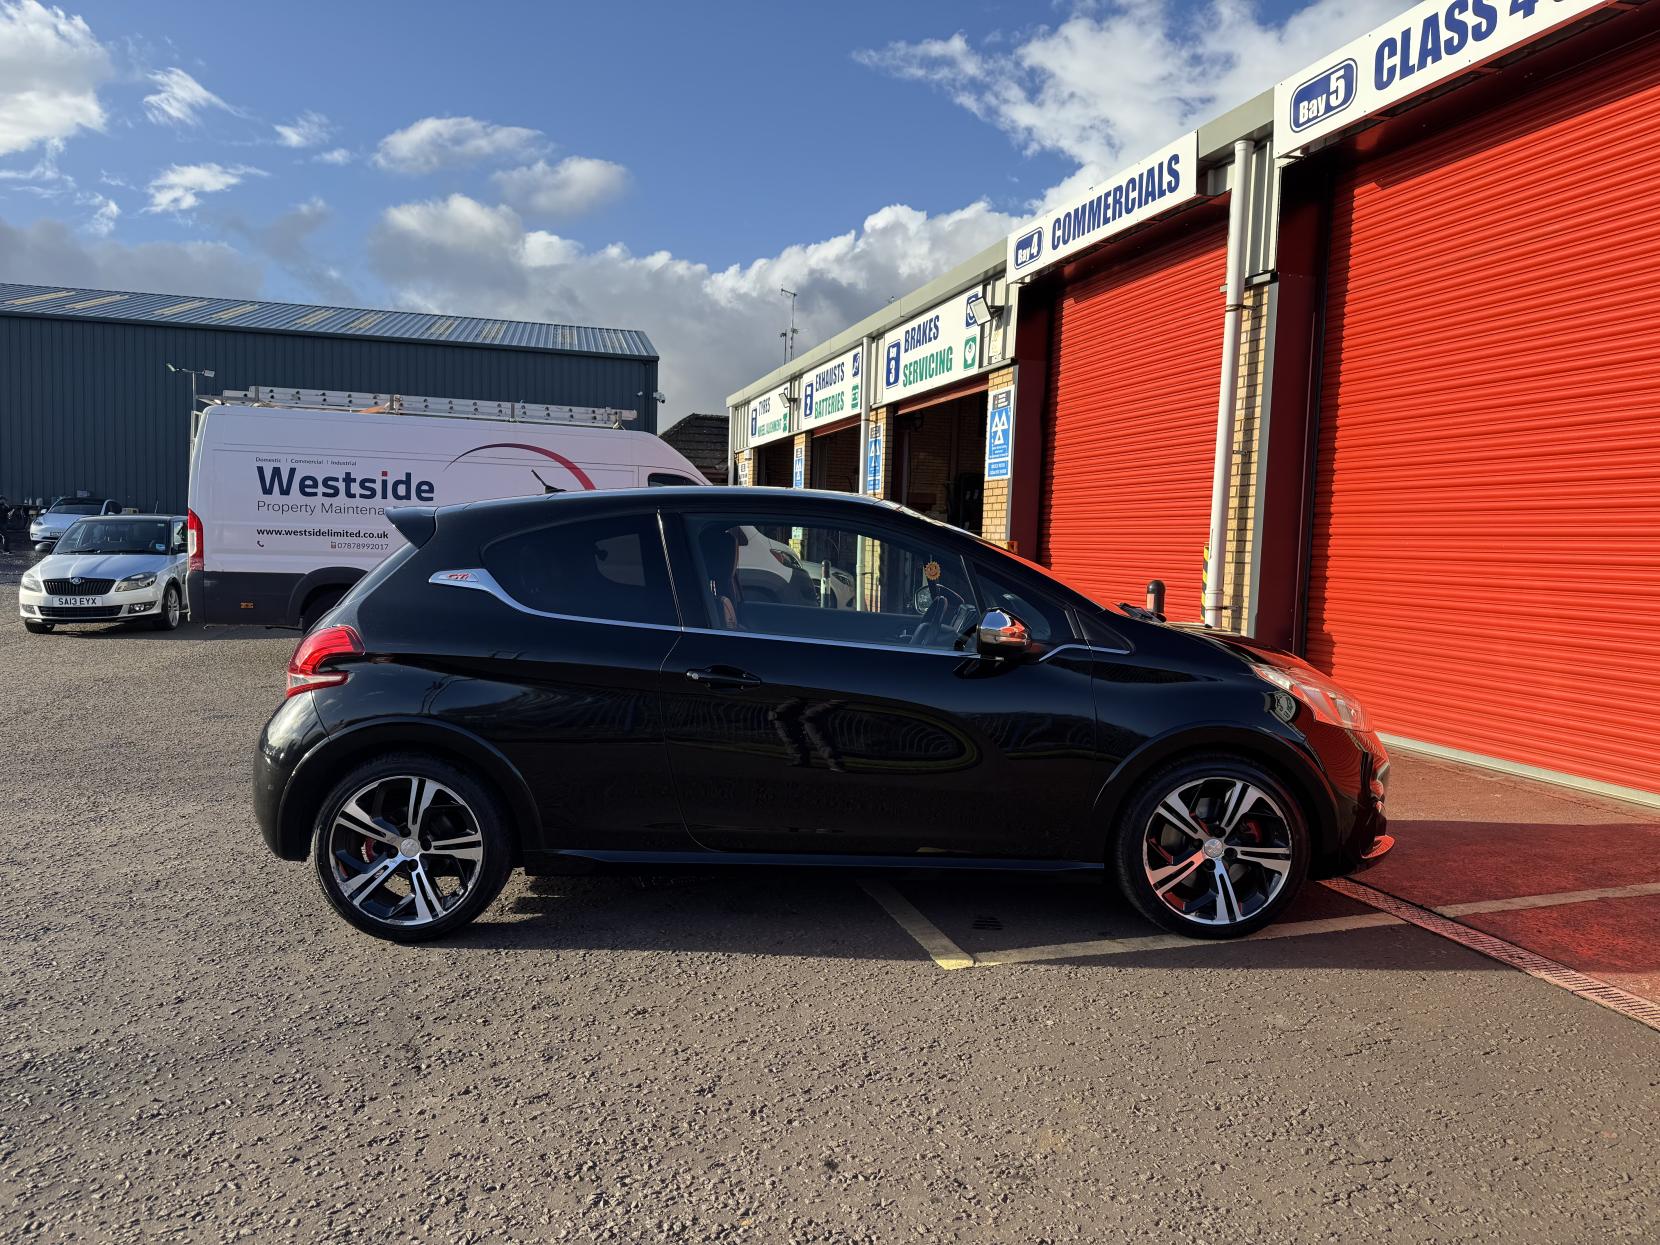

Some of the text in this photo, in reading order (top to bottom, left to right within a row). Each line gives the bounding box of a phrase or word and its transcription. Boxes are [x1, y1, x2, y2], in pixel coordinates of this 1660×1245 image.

[1373, 0, 1498, 91] CLASS
[1299, 68, 1346, 124] Bay 5
[1051, 153, 1181, 251] COMMERCIALS
[1030, 232, 1039, 257] 4
[904, 315, 940, 353] BRAKES
[815, 362, 845, 392] EXHAUSTS
[889, 359, 896, 384] 3
[902, 345, 954, 388] SERVICING
[814, 391, 845, 419] BATTERIES
[255, 456, 281, 464] Domestic
[256, 465, 435, 502] Westside
[257, 500, 385, 516] Property Maintena
[256, 528, 389, 540] www.westsidelimited.co.uk
[337, 542, 389, 551] 07878992017
[58, 597, 97, 606] SA13 EYX
